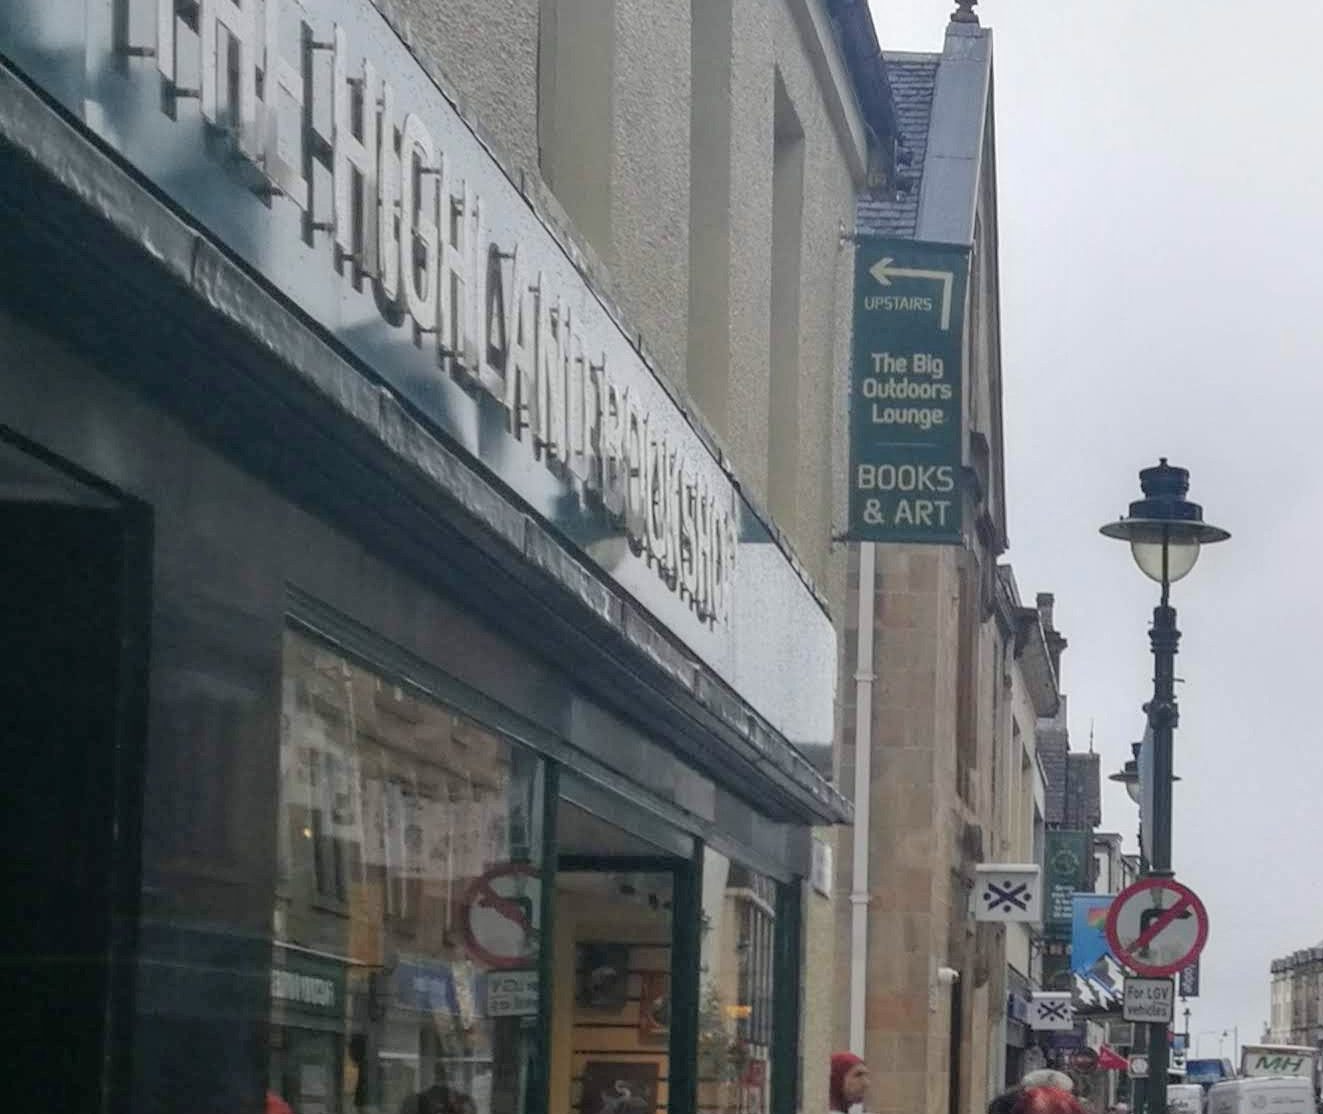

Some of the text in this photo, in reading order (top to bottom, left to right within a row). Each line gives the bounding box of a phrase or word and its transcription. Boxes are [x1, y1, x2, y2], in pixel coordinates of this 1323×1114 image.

[333, 20, 598, 485] HIGHLAND
[864, 296, 933, 312] UPSTAIRS
[871, 353, 944, 379] The Big
[862, 377, 952, 400] Outdoors
[871, 403, 944, 430] Lounge
[857, 463, 955, 493] BOOKS
[862, 498, 951, 526] & ART
[1127, 985, 1170, 1000] For LGV
[1127, 1004, 1168, 1017] vehicles
[1256, 1055, 1304, 1073] MH
